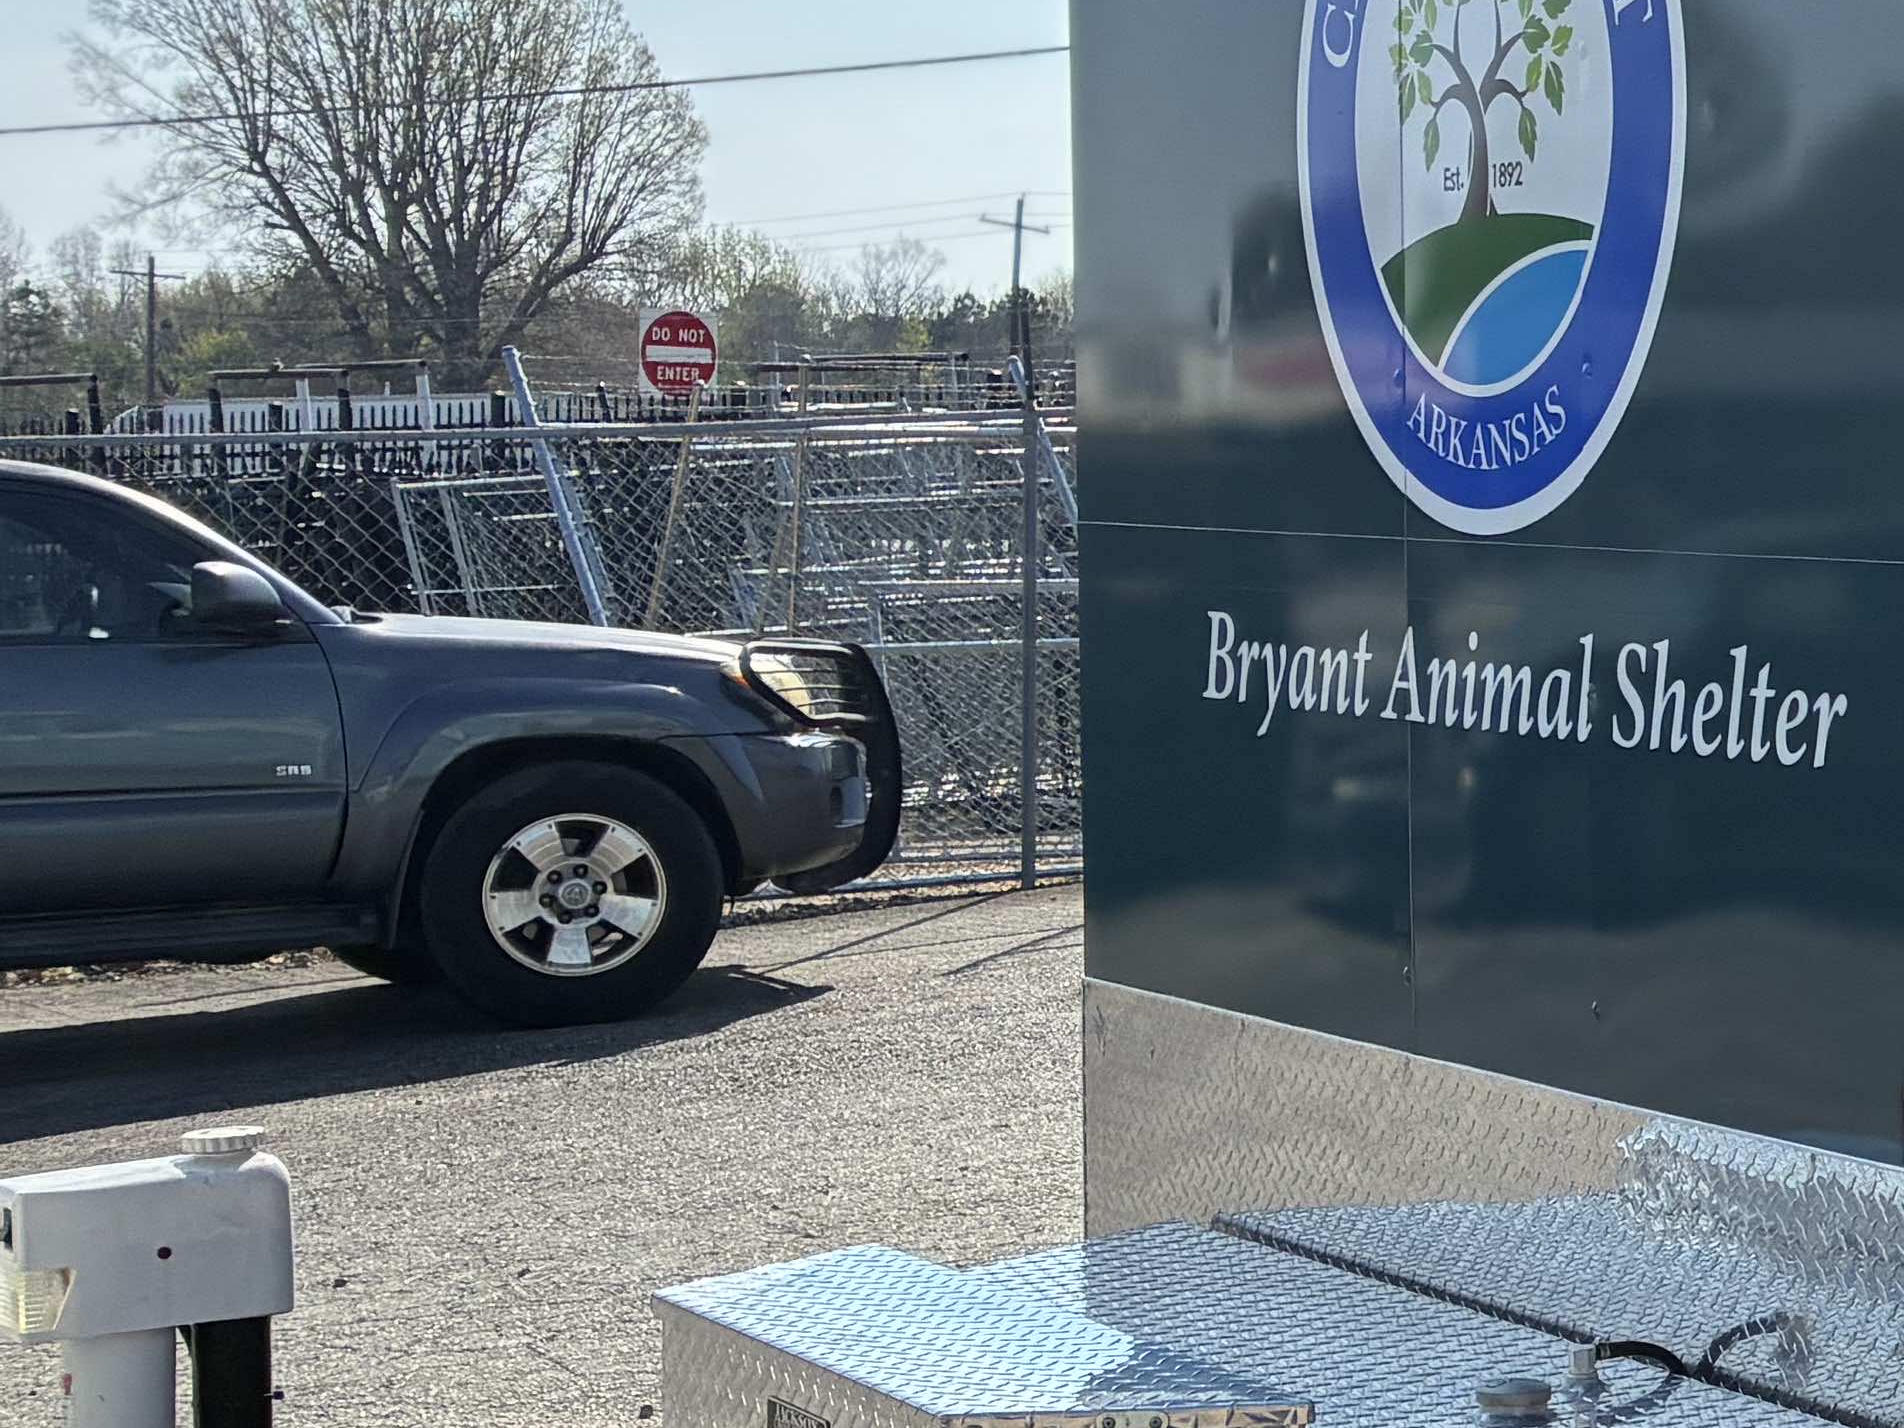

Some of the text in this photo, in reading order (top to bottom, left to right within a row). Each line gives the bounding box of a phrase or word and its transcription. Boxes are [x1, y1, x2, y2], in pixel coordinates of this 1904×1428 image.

[1443, 161, 1524, 194] Est. 1892
[652, 327, 706, 343] DO NOT
[657, 365, 700, 381] ENTER
[1406, 383, 1568, 472] ARKANSAS
[1202, 609, 1848, 768] Bryant Animal Shelter
